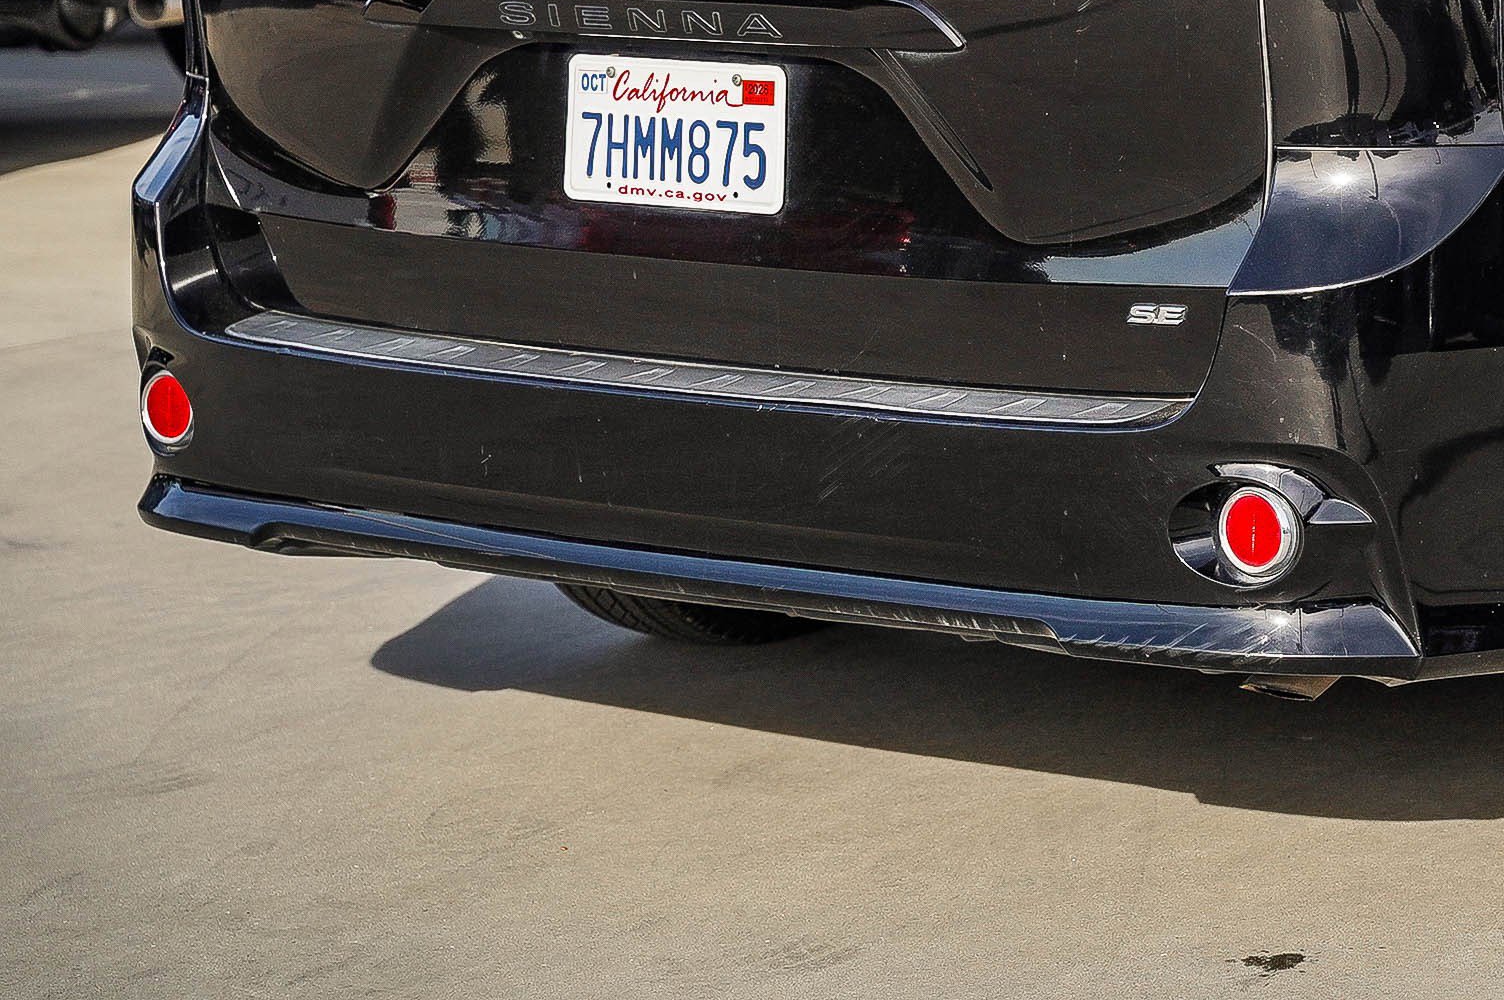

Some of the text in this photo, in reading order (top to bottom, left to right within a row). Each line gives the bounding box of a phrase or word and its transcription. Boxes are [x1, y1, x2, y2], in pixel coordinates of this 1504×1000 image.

[499, 1, 783, 40] SIENNA
[581, 73, 607, 92] OCT
[612, 69, 743, 113] California
[582, 112, 767, 190] 7HMM875
[618, 184, 727, 202] dmv.ca.gov
[1126, 303, 1187, 326] SE
